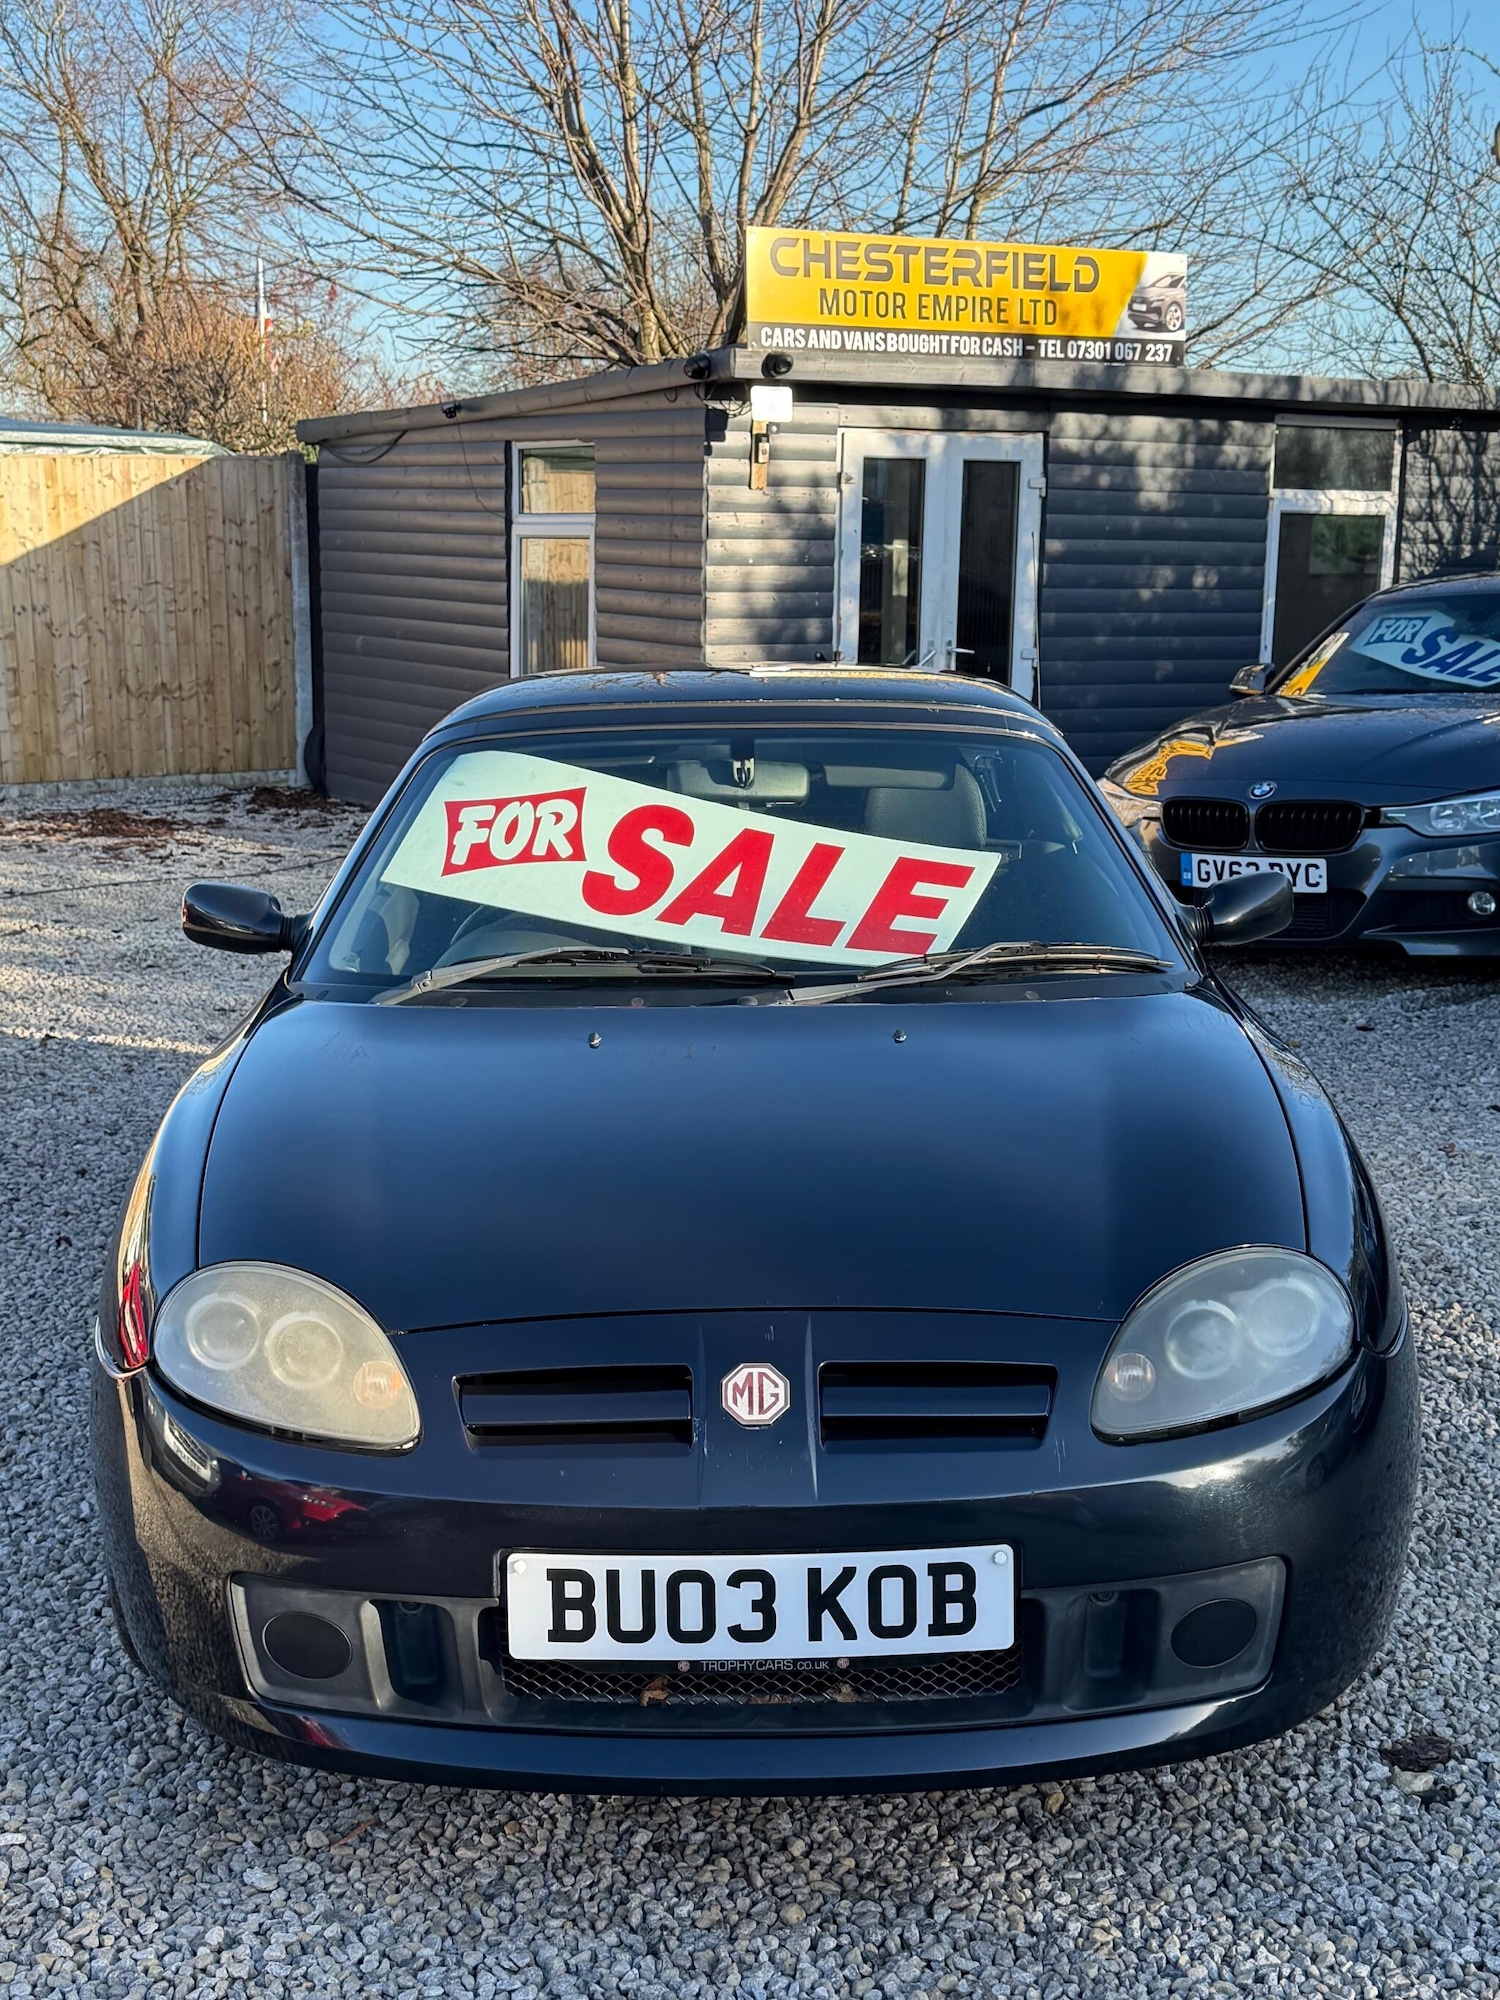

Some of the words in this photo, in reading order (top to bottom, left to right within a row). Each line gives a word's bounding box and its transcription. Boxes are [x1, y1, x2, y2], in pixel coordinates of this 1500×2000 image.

[770, 236, 1100, 293] CHESTERFIELD
[819, 288, 907, 319] MOTOR
[918, 293, 1009, 324] EMPIRE
[1019, 298, 1057, 326] LTD
[760, 326, 806, 349] CARS
[807, 328, 842, 350] AND
[843, 331, 885, 351] VANS
[886, 333, 949, 354] BOUGHT
[950, 335, 981, 356] FOR
[982, 336, 1023, 357] CASH
[1038, 339, 1065, 359] TEL
[1067, 341, 1111, 360] 07301
[1114, 342, 1142, 361] 067
[1145, 344, 1173, 362] 237
[1369, 618, 1424, 643] FOR
[449, 797, 579, 866] FOR
[581, 804, 977, 956] SALE
[731, 1371, 780, 1416] MG
[546, 1567, 777, 1645] BU03
[806, 1561, 977, 1642] KOB
